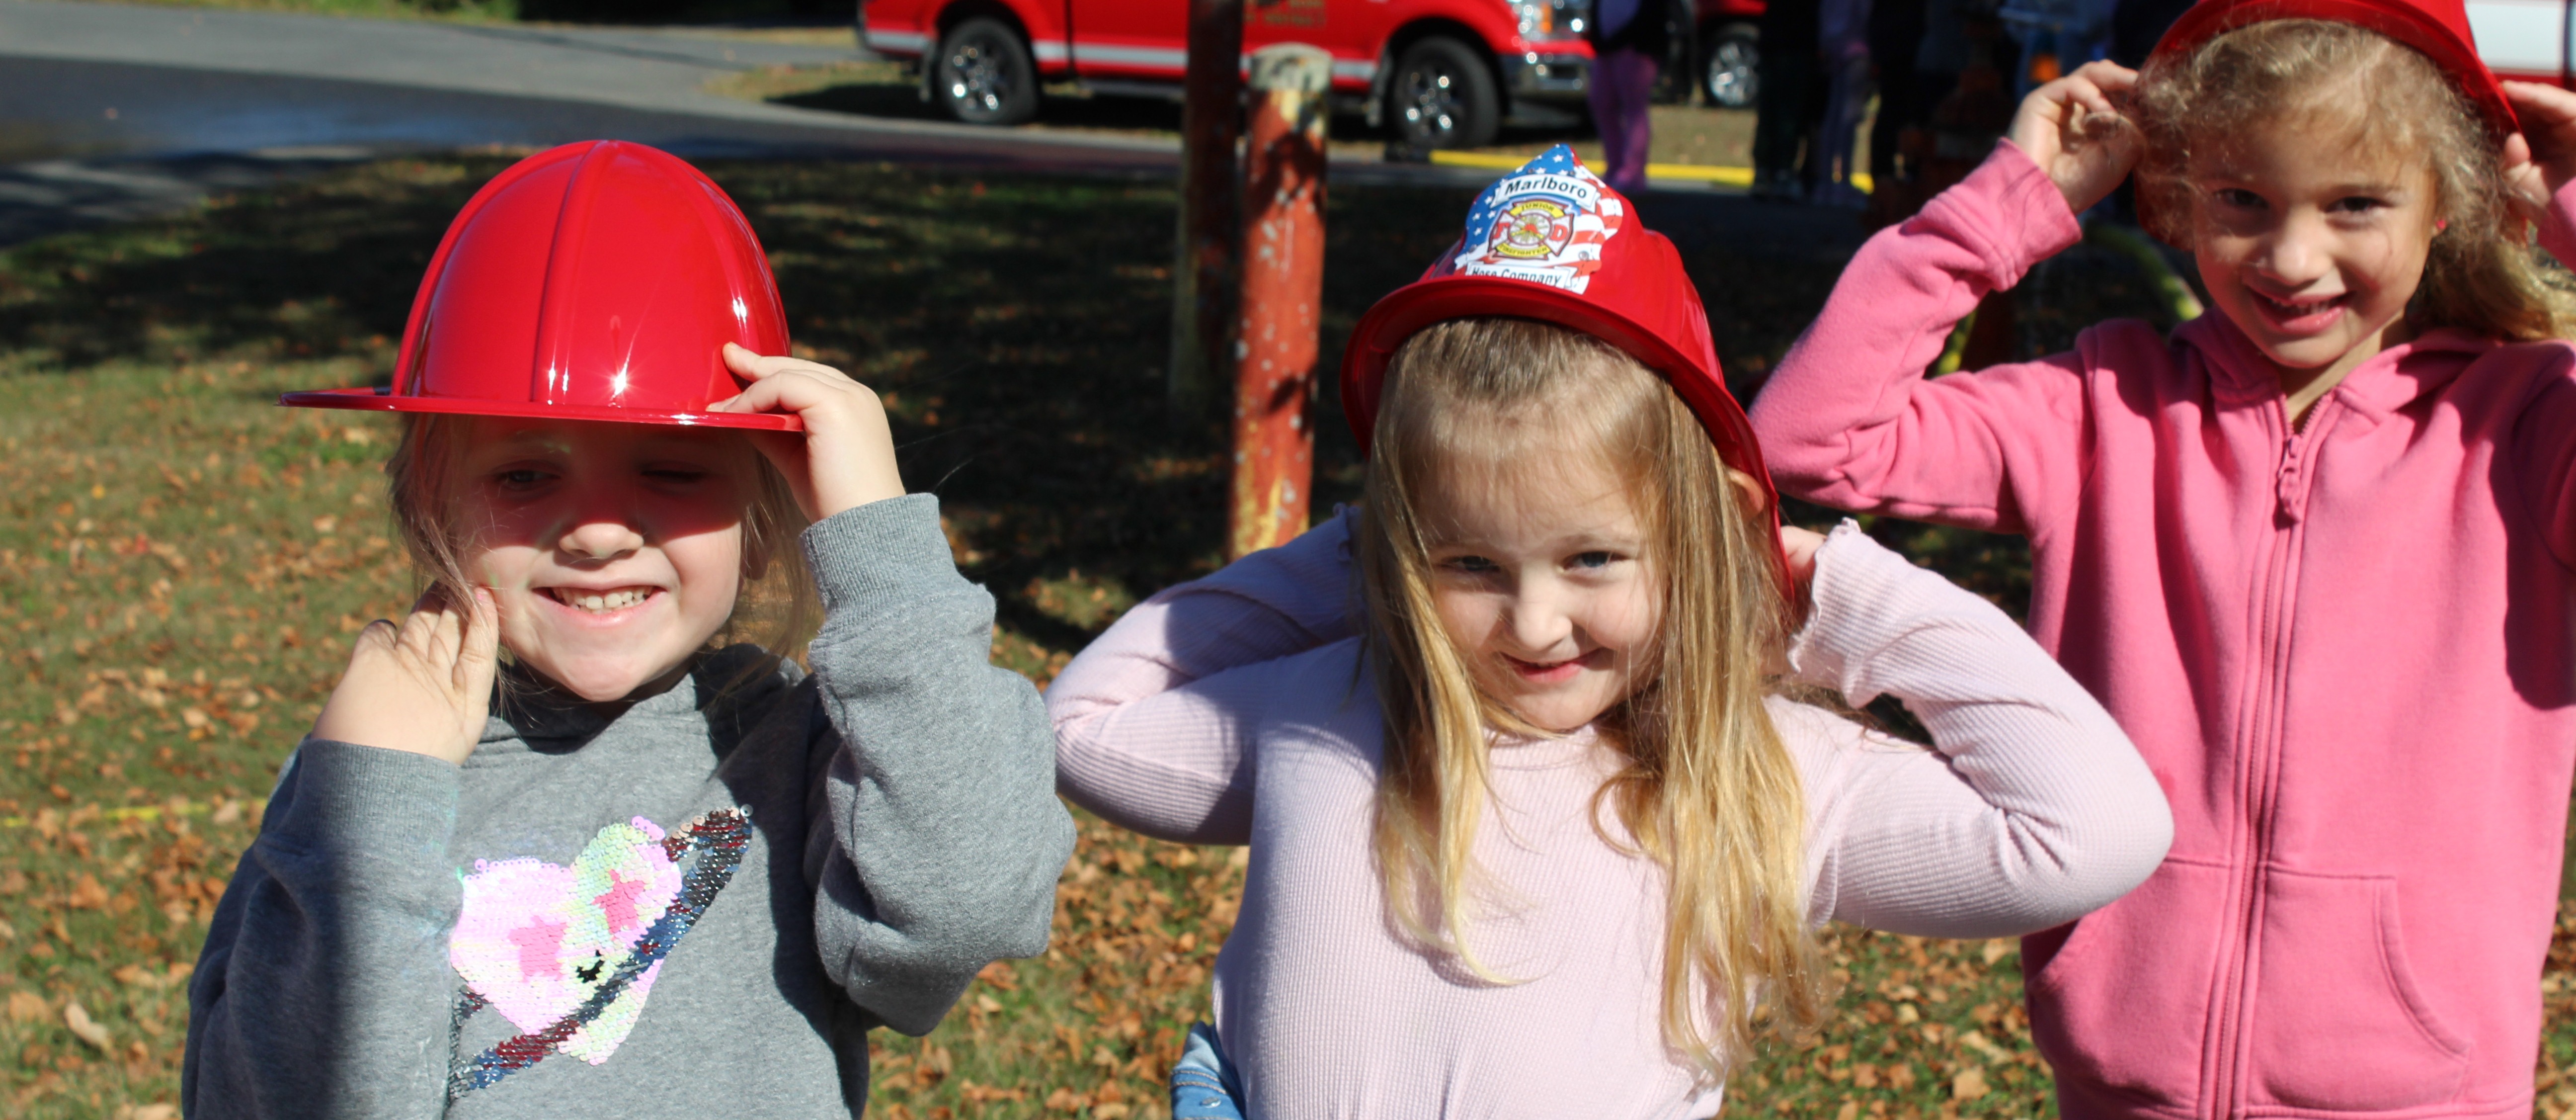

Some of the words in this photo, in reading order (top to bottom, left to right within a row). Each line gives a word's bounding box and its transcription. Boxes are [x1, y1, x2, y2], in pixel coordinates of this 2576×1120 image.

[1505, 176, 1587, 198] Marlboro
[1521, 202, 1554, 211] JUNIOR
[1549, 224, 1568, 242] D
[1502, 268, 1562, 287] Company
